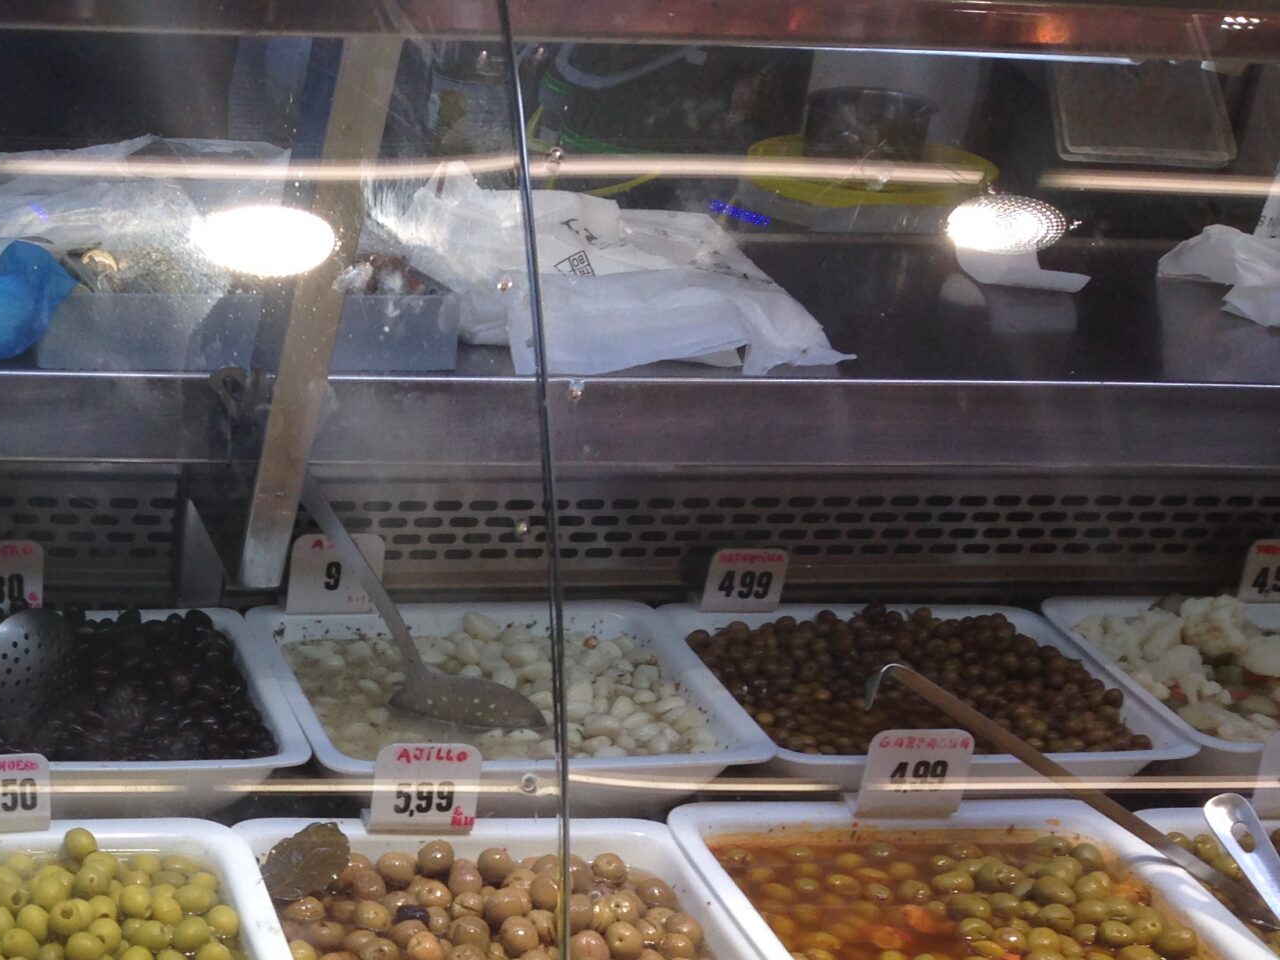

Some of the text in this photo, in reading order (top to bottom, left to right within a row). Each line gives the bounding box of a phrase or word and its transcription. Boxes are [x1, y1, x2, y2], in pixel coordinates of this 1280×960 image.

[324, 561, 342, 591] 9
[717, 570, 773, 599] 499
[393, 781, 456, 817] 5,99
